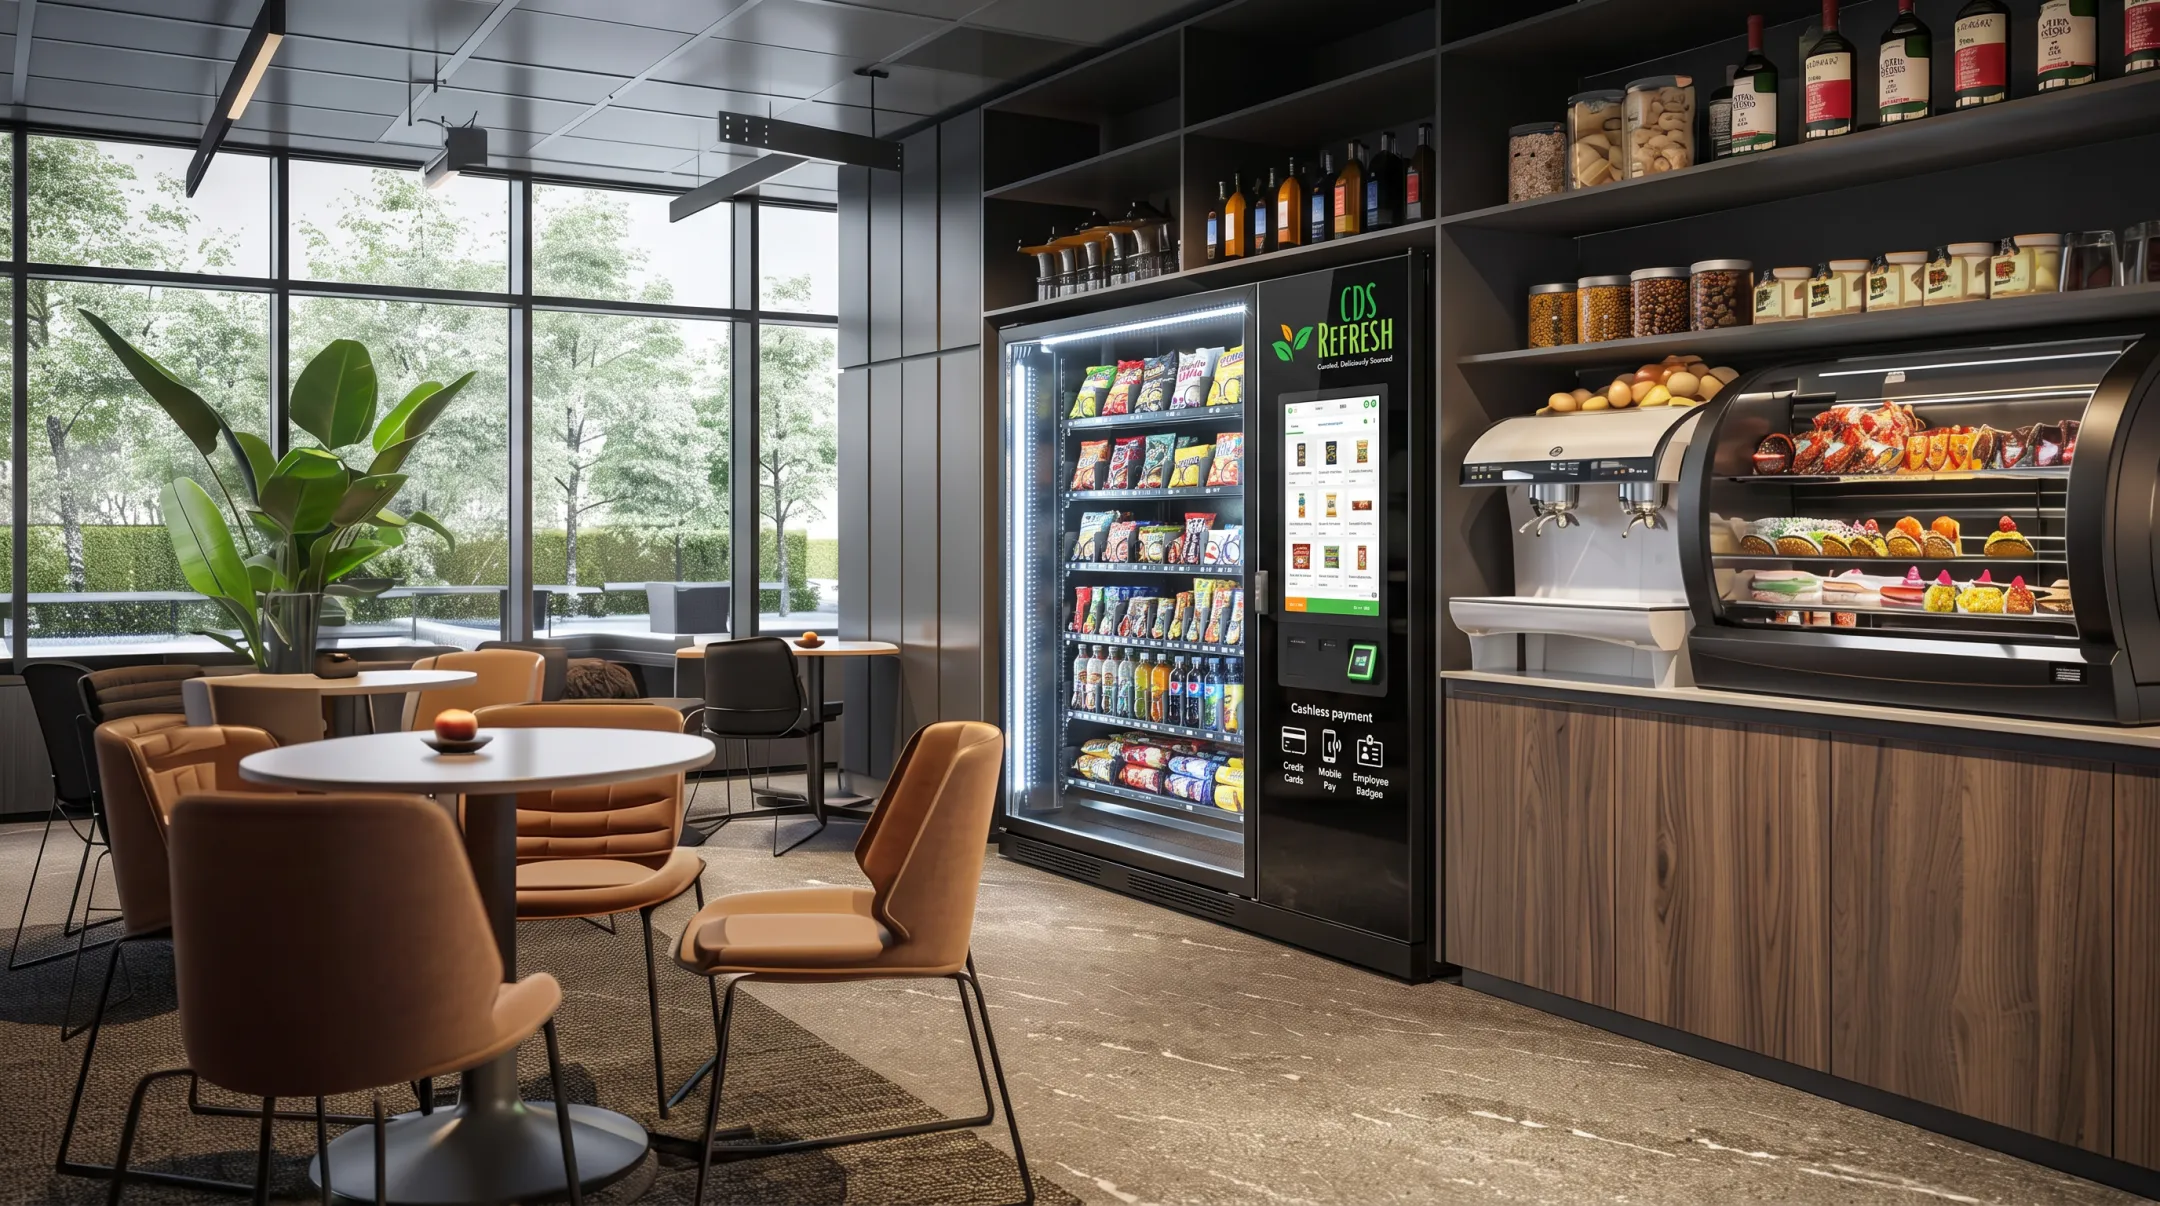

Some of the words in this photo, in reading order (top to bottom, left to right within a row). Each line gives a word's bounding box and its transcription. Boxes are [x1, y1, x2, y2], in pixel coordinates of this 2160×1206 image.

[1340, 282, 1377, 322] CDS
[1318, 318, 1393, 358] REFRESH
[1291, 702, 1330, 718] Cashless
[1331, 709, 1373, 724] payment
[1283, 761, 1304, 773] Credit
[1318, 766, 1342, 780] Mobile
[1284, 773, 1304, 785] Cards
[1352, 772, 1389, 787] Employee
[1323, 780, 1337, 793] Pay
